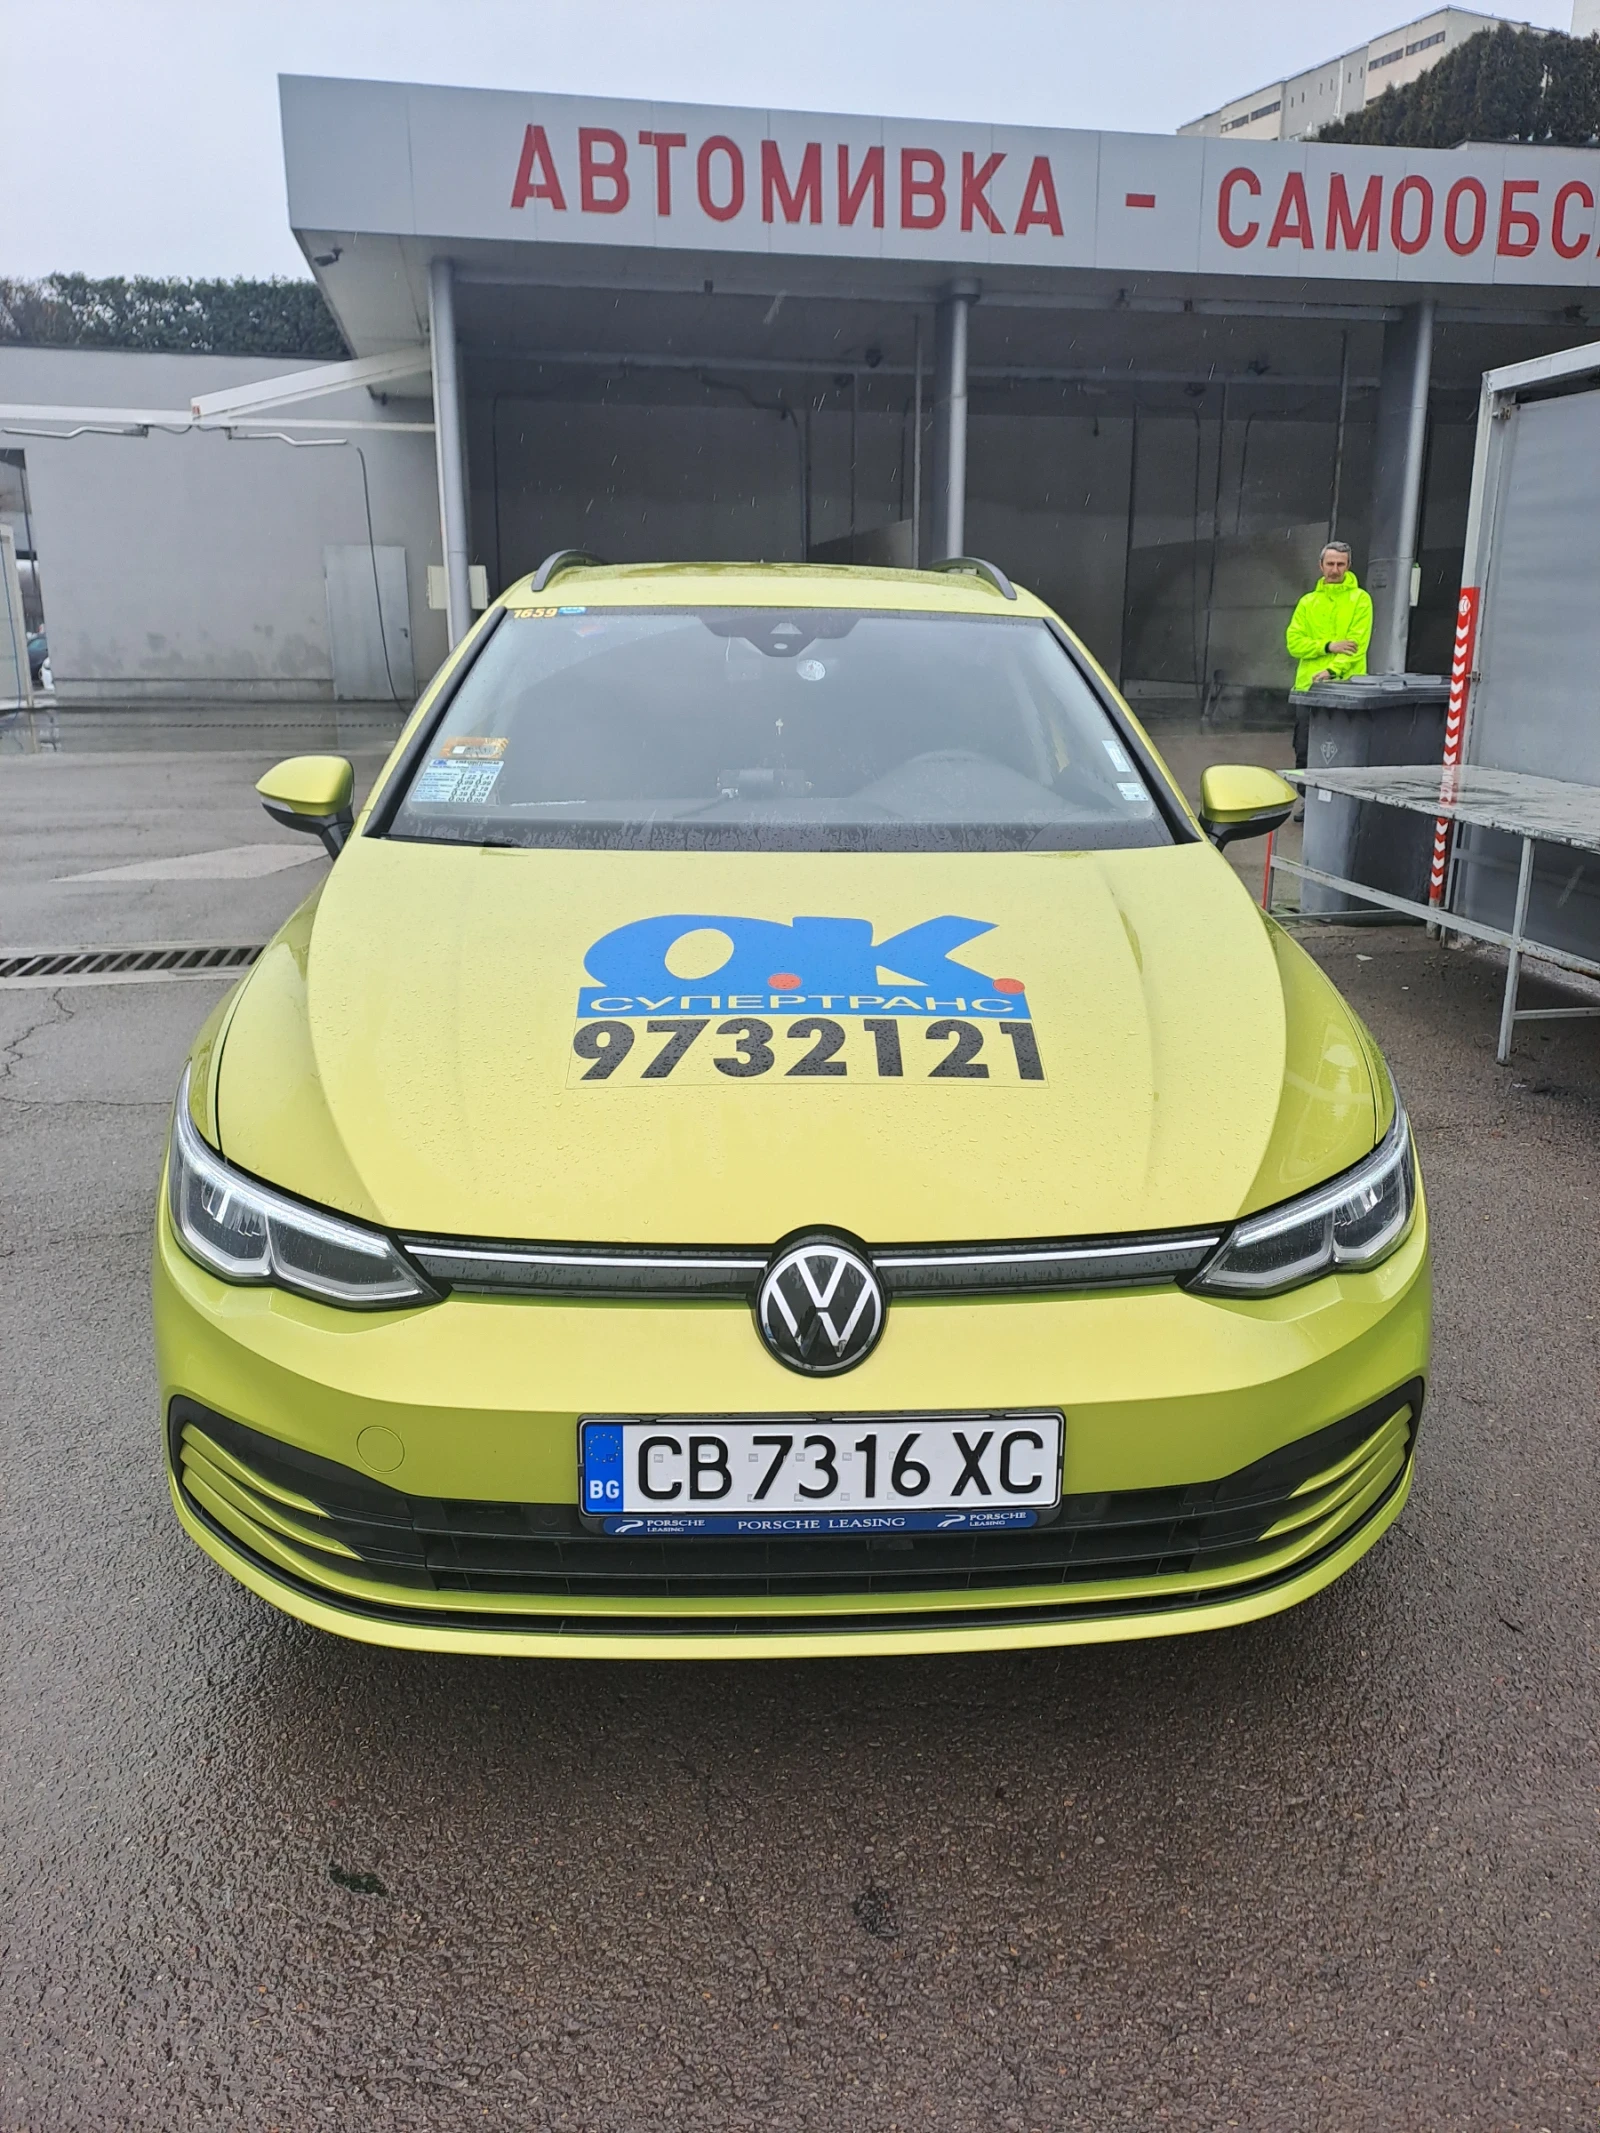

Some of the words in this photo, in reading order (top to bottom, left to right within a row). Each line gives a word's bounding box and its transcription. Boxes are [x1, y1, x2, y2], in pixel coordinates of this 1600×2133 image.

[511, 124, 1064, 237] АВТОМИВКА
[1218, 166, 1600, 260] САМООБС
[513, 608, 558, 619] 1659
[590, 995, 1015, 1013] СУПЕРТРАНС
[573, 1018, 1046, 1081] 9732121
[752, 1431, 931, 1500] 7316
[589, 1480, 620, 1499] BG
[646, 1519, 706, 1527] PORSCHE
[738, 1520, 820, 1530] PORSCHE
[828, 1517, 906, 1529] LEASING
[969, 1512, 1027, 1521] PORSCHE
